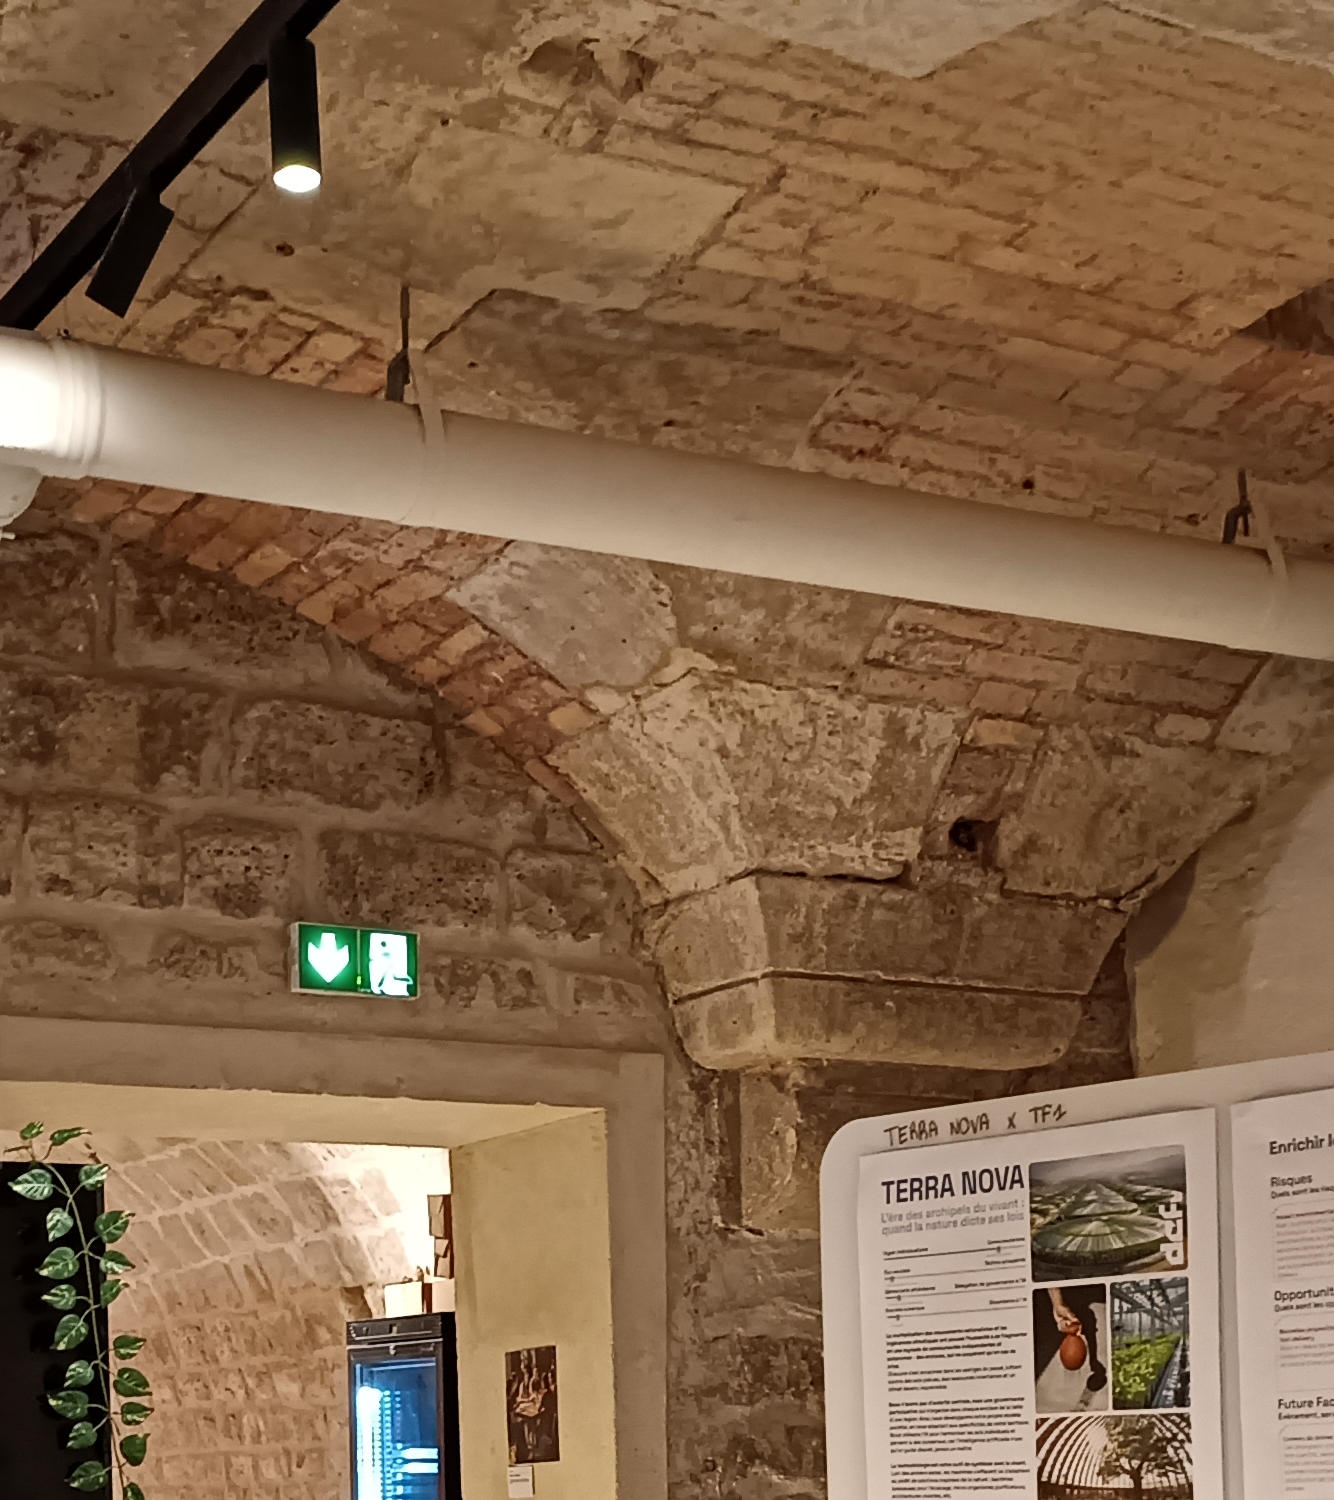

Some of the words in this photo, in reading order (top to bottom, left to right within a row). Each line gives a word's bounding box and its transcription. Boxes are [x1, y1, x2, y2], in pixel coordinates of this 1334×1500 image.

[883, 1119, 939, 1147] TERRA
[949, 1112, 990, 1136] NOVA
[1028, 1103, 1067, 1123] TF1
[1269, 1135, 1325, 1155] Enrichir
[880, 1173, 955, 1205] TERRA
[961, 1164, 1025, 1196] NOVA
[1270, 1174, 1313, 1188] Risques
[905, 1208, 923, 1221] des
[925, 1204, 970, 1221] archipels
[973, 1201, 987, 1214] du
[989, 1199, 1019, 1211] vivant
[881, 1220, 912, 1236] quand
[914, 1219, 923, 1232] la
[925, 1216, 958, 1230] nature
[960, 1213, 986, 1227] dicte
[988, 1213, 1004, 1224] ses
[1006, 1210, 1025, 1222] lois
[1277, 1398, 1314, 1410] Future
